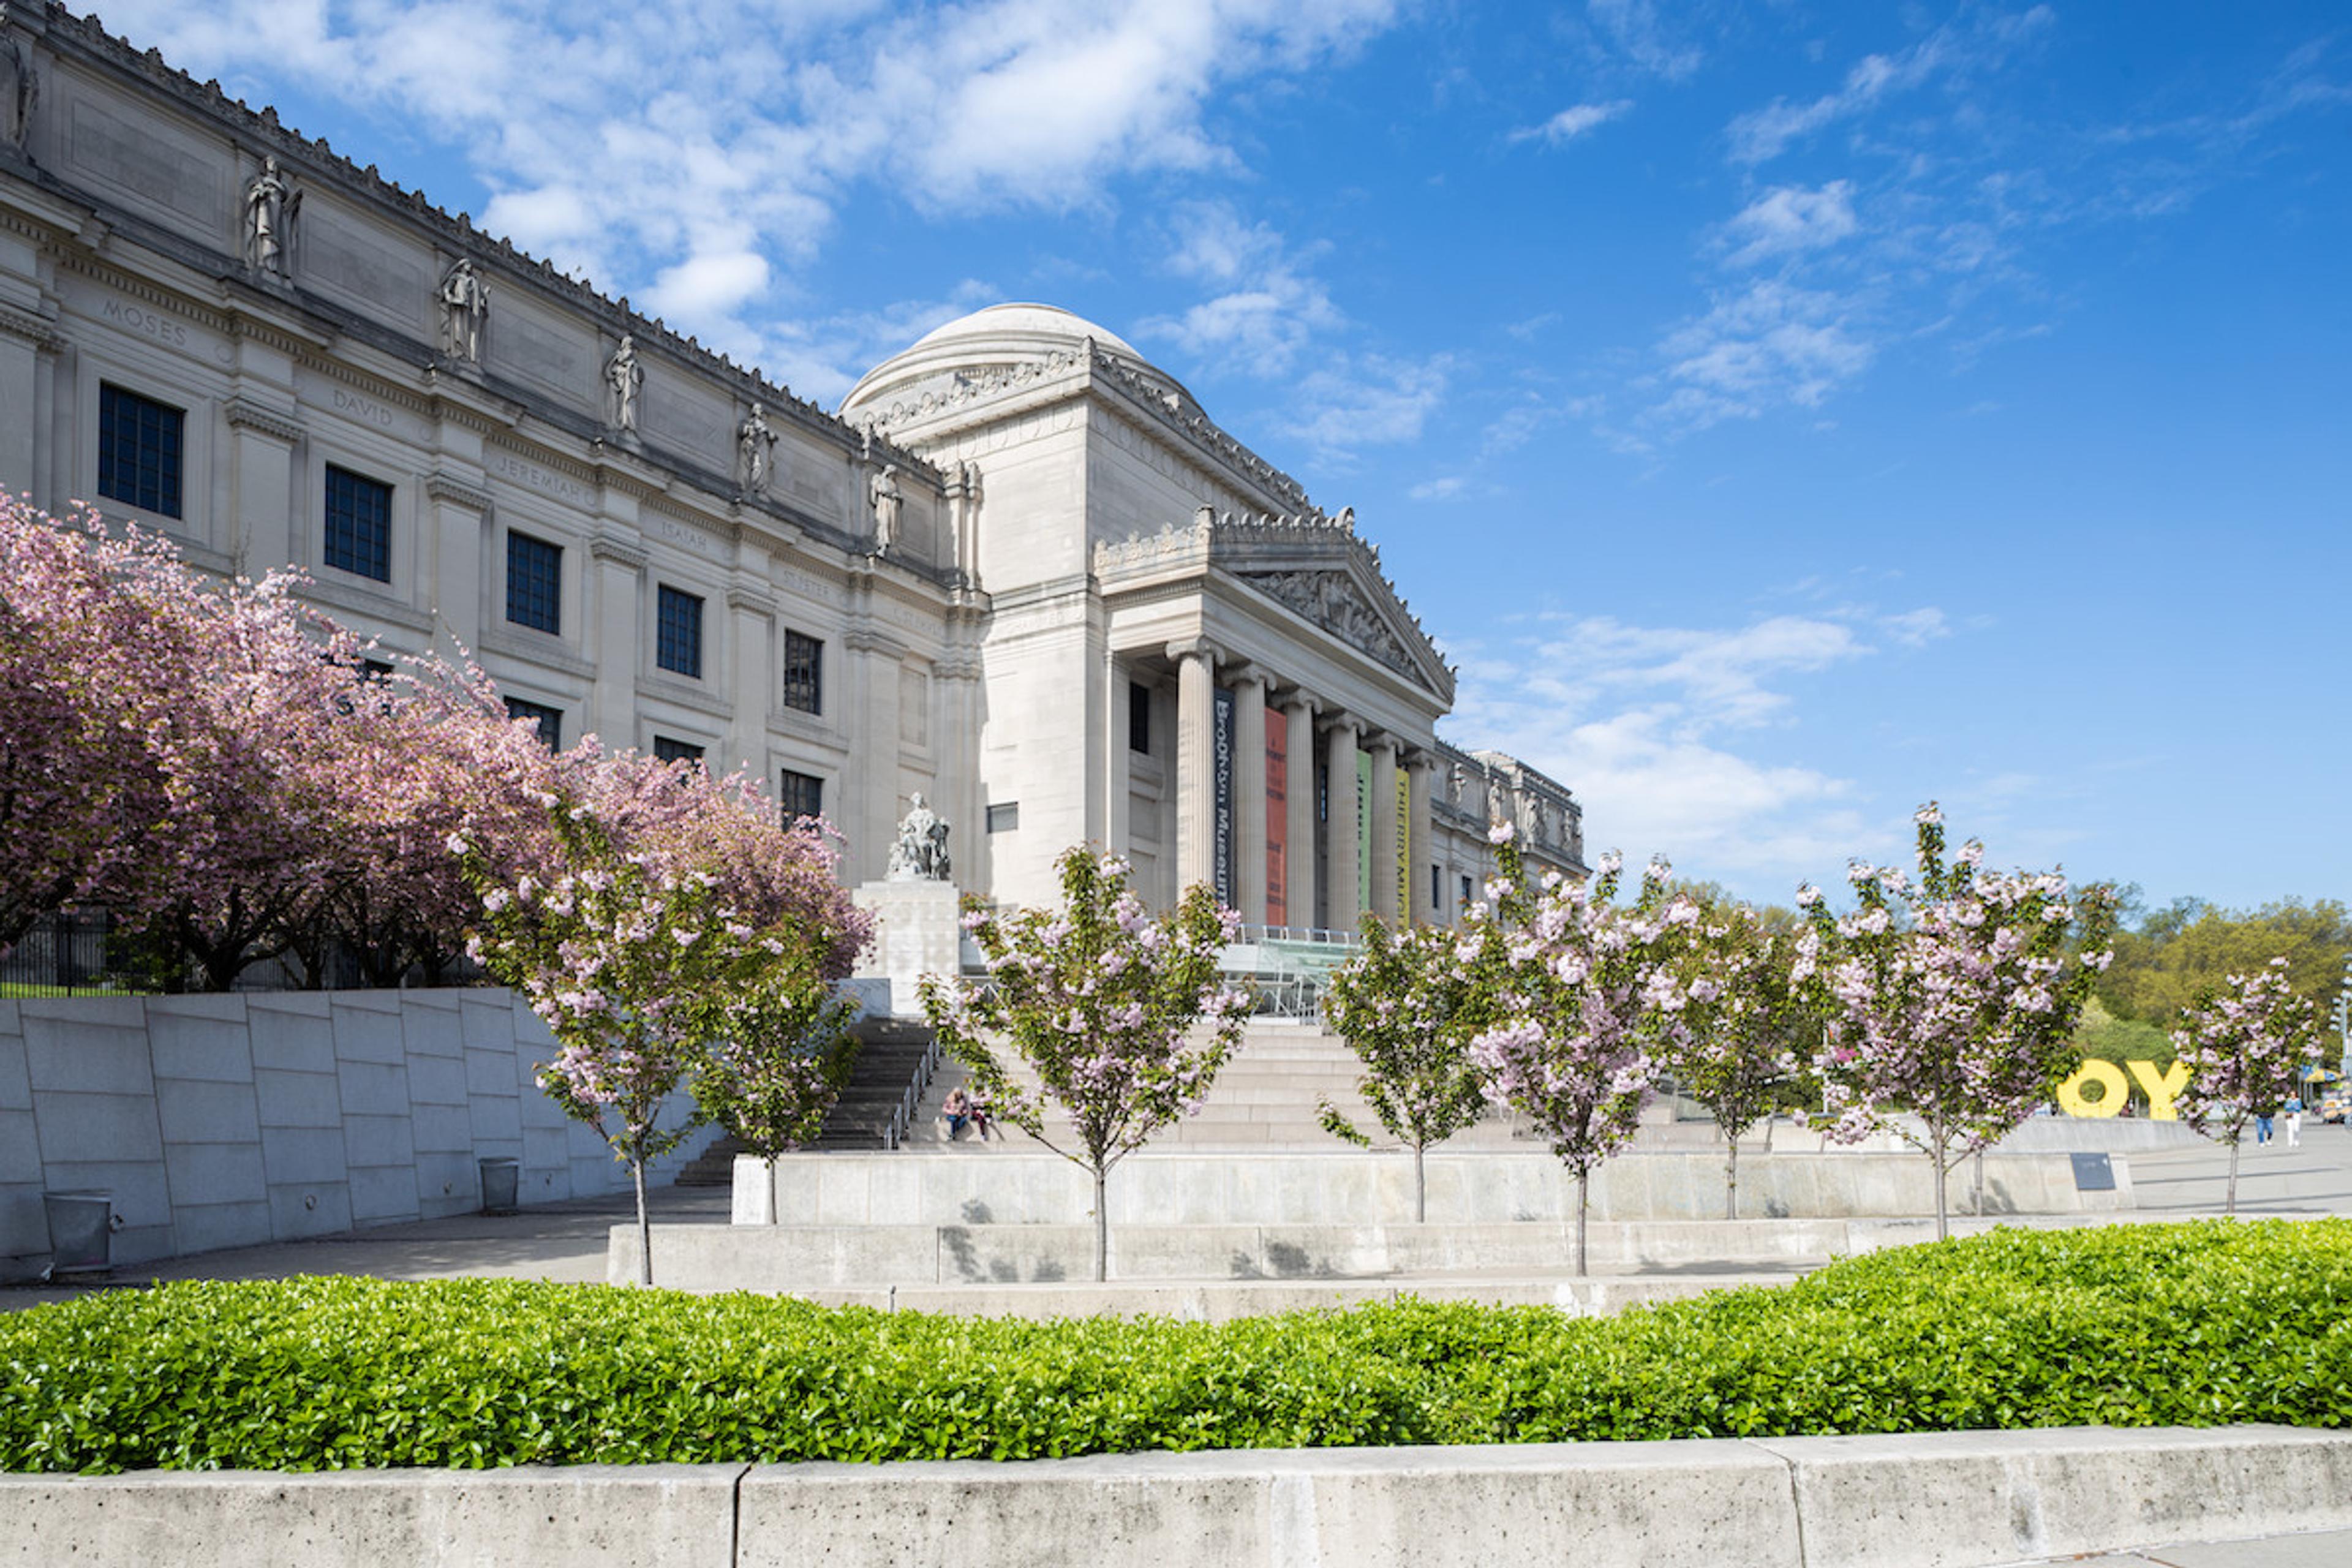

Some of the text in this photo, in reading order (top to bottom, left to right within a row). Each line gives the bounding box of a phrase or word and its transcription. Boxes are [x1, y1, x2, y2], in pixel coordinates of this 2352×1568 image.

[103, 298, 187, 346] MOSES
[333, 389, 393, 426] DAVID
[499, 456, 579, 502] JEREMIAH
[662, 521, 707, 551] ISAIAH
[1216, 699, 1229, 906] Brooklyn Museum
[1397, 781, 1406, 862] THIERRY
[2056, 1058, 2194, 1120] OY
